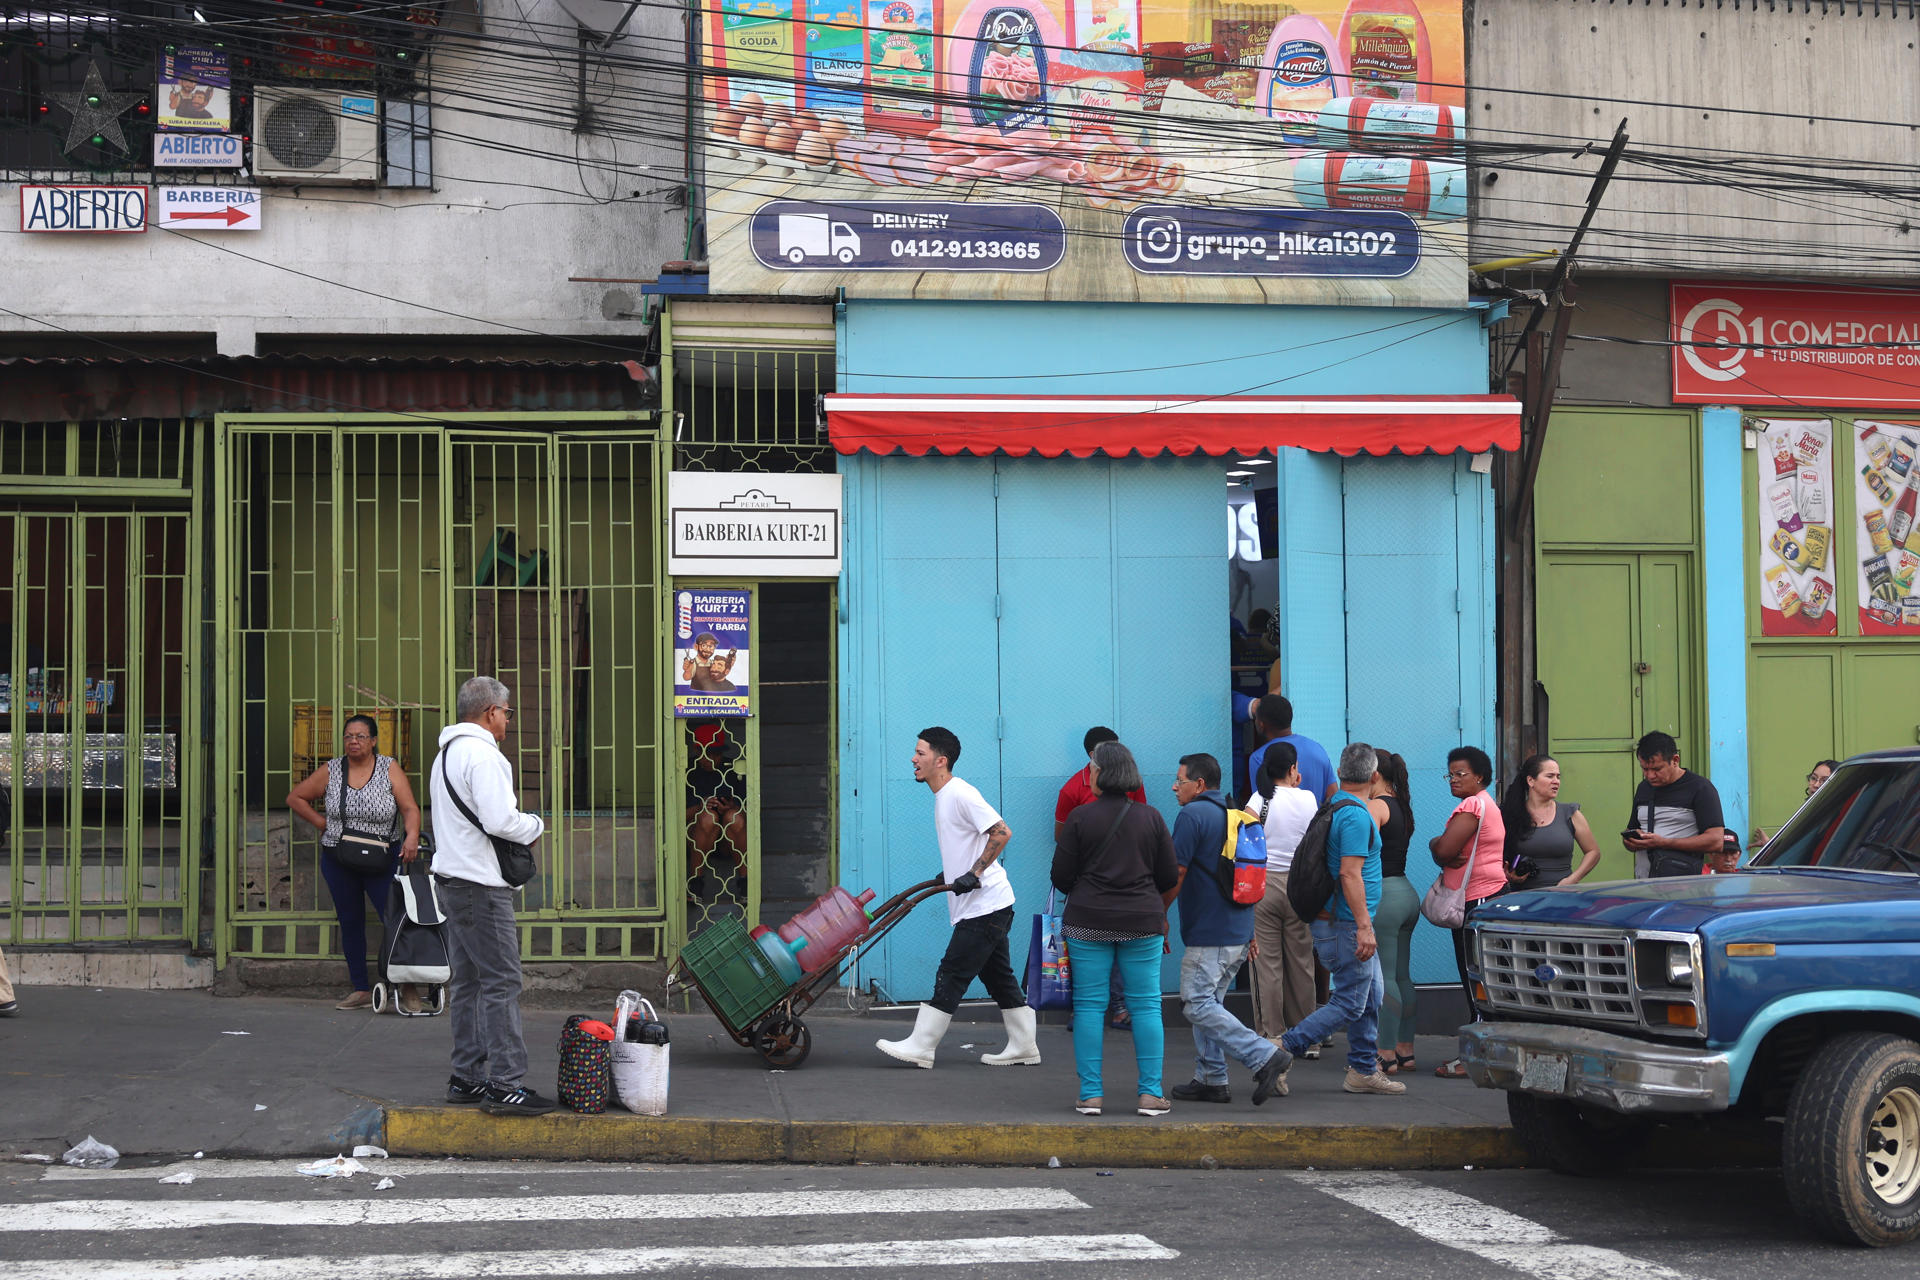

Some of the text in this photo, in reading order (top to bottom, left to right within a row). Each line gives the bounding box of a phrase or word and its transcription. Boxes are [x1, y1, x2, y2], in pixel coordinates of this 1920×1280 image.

[740, 37, 778, 46] GOUDA
[1359, 40, 1409, 53] Millennium
[814, 60, 863, 70] BLANCO
[1356, 57, 1378, 65] Jamón
[1389, 62, 1411, 70] Pierna
[160, 137, 237, 155] ABIERTO
[166, 190, 255, 203] BARBERIA
[1349, 194, 1404, 203] MORTADELA
[28, 190, 145, 229] ABIERTO
[872, 213, 949, 229] DELIVERY
[890, 239, 1041, 260] 0412-9133665
[1771, 350, 1787, 362] TU
[1790, 350, 1875, 365] DISTRIBUIDOR
[1878, 353, 1893, 366] DE
[684, 523, 827, 542] BARBERIA KURT-21
[694, 596, 746, 604] BARBERIA
[696, 604, 744, 613] KURT 21
[715, 623, 747, 631] BARBA
[686, 697, 738, 705] ENTRADA
